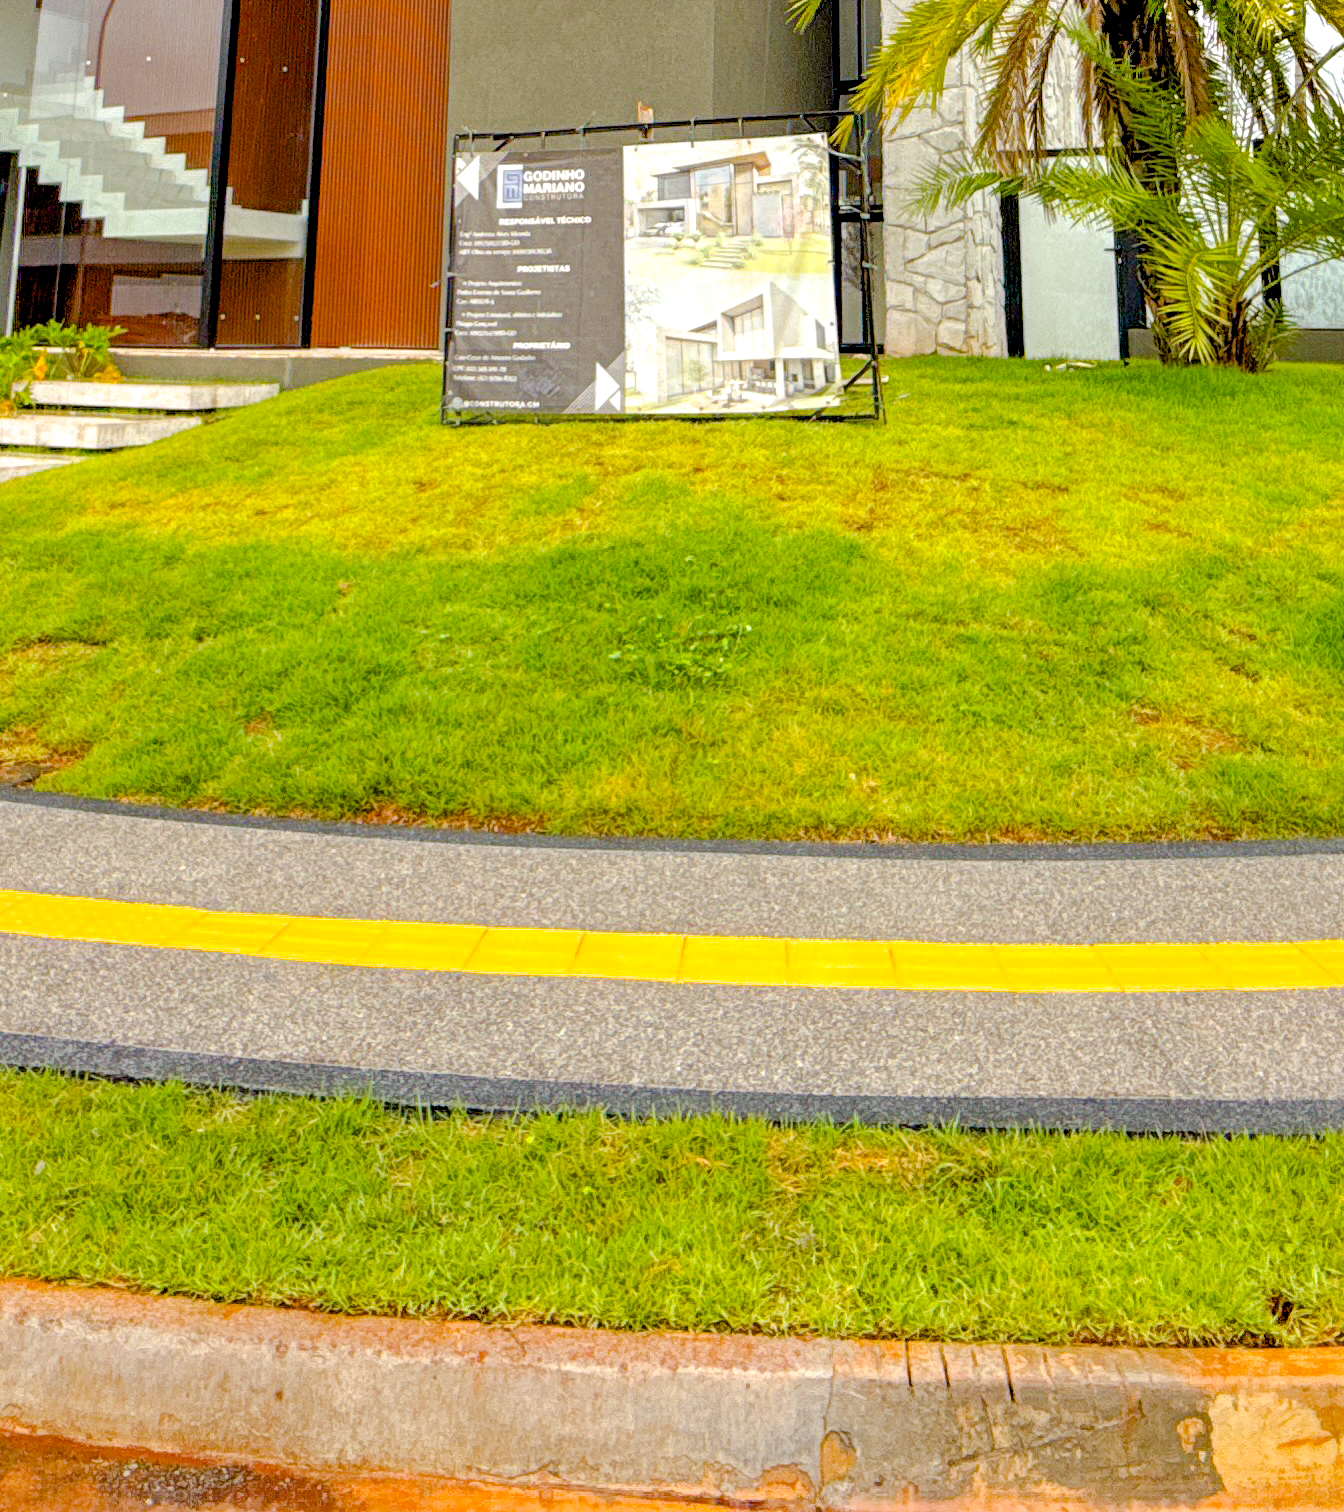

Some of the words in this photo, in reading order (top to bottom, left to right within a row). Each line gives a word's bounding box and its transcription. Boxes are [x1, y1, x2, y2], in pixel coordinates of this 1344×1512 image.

[523, 168, 585, 182] GODINHO
[523, 181, 585, 194] MARIANO
[523, 193, 584, 201] CONSTRUTORA
